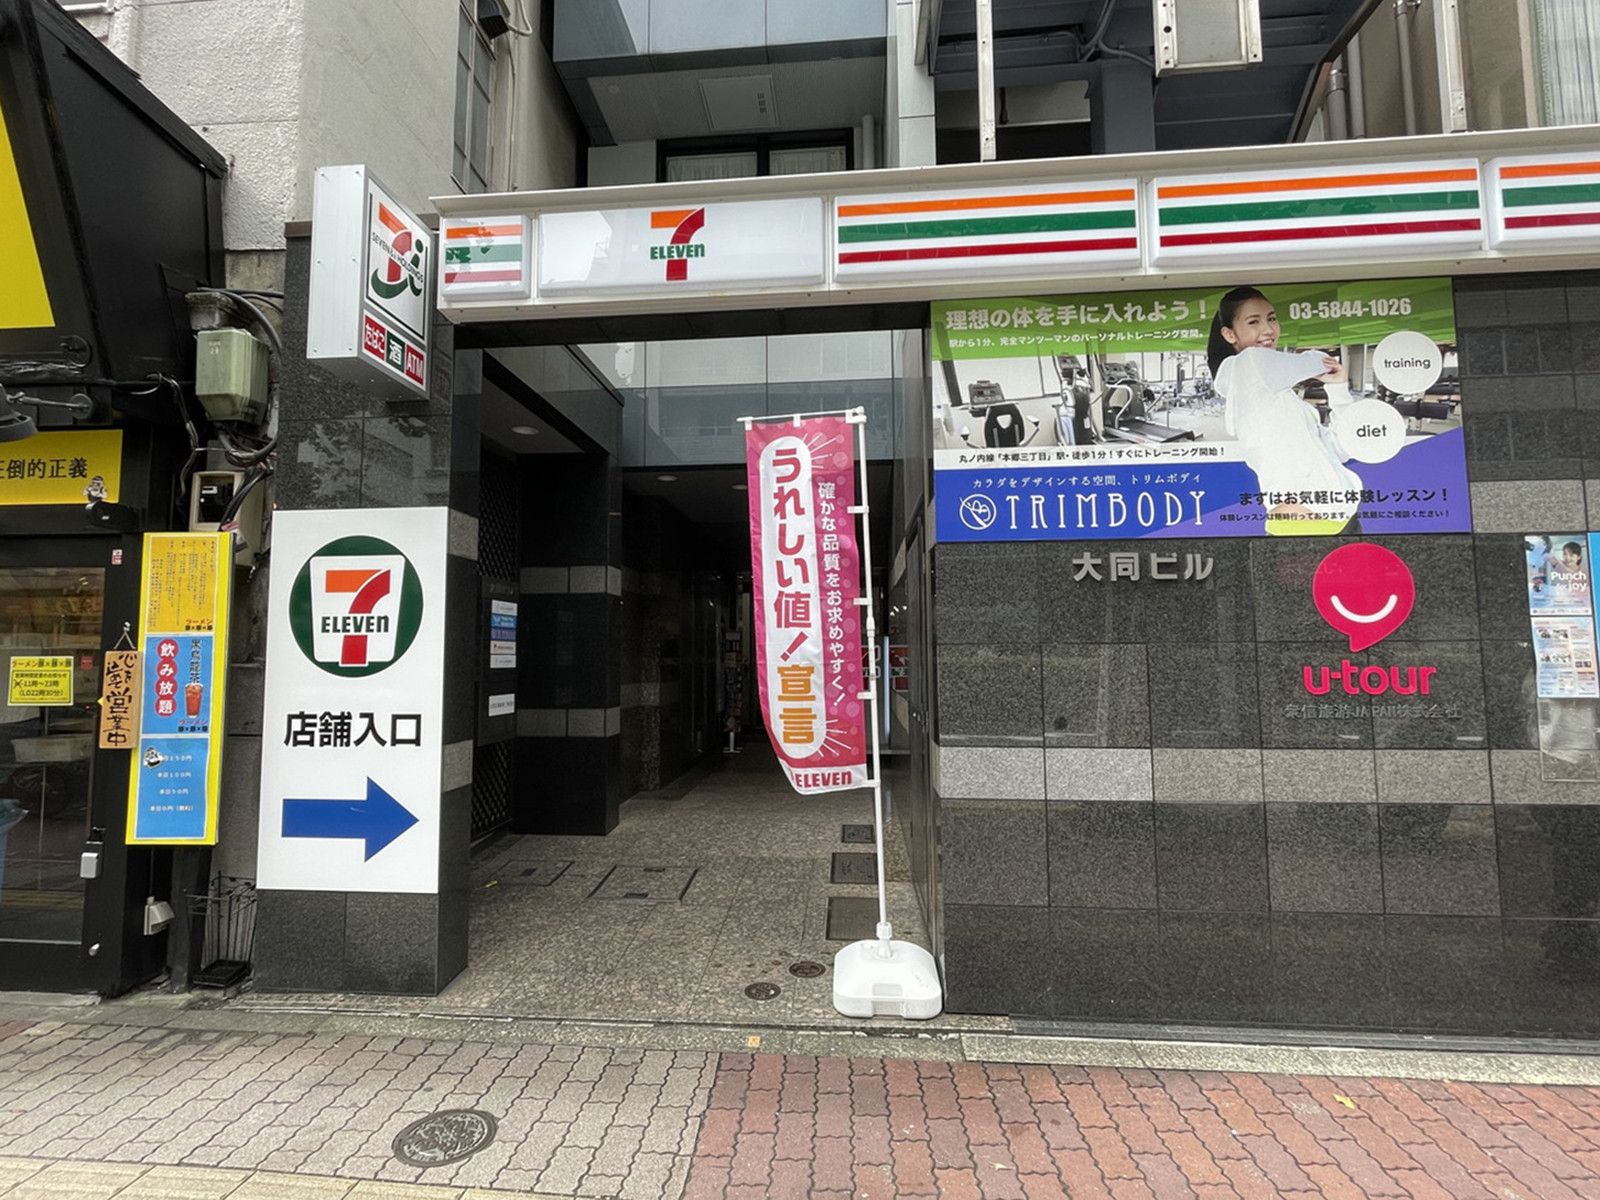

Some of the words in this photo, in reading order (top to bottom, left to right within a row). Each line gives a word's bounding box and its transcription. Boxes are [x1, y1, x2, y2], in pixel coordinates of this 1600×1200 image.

[945, 300, 1207, 331] 理想の体を手に入れよう！
[1289, 298, 1412, 320] 03-5844-1026
[365, 323, 385, 354] たばこ
[389, 339, 403, 365] 酒
[406, 352, 424, 380] ATM
[1384, 357, 1432, 369] training
[1356, 424, 1388, 438] diet
[1005, 490, 1206, 530] TRIMBODY
[1239, 488, 1448, 506] まずはお気軽に体験レッスン！
[1072, 551, 1214, 582] 大同ビル
[1551, 570, 1587, 580] Punch
[817, 481, 846, 706] 確かな品質をお求めやすく！
[1568, 580, 1588, 592] joy
[158, 642, 176, 715] 飲み放題
[1303, 659, 1437, 696] u-tour
[103, 686, 133, 747] 営業中
[283, 711, 422, 748] 店舗入口
